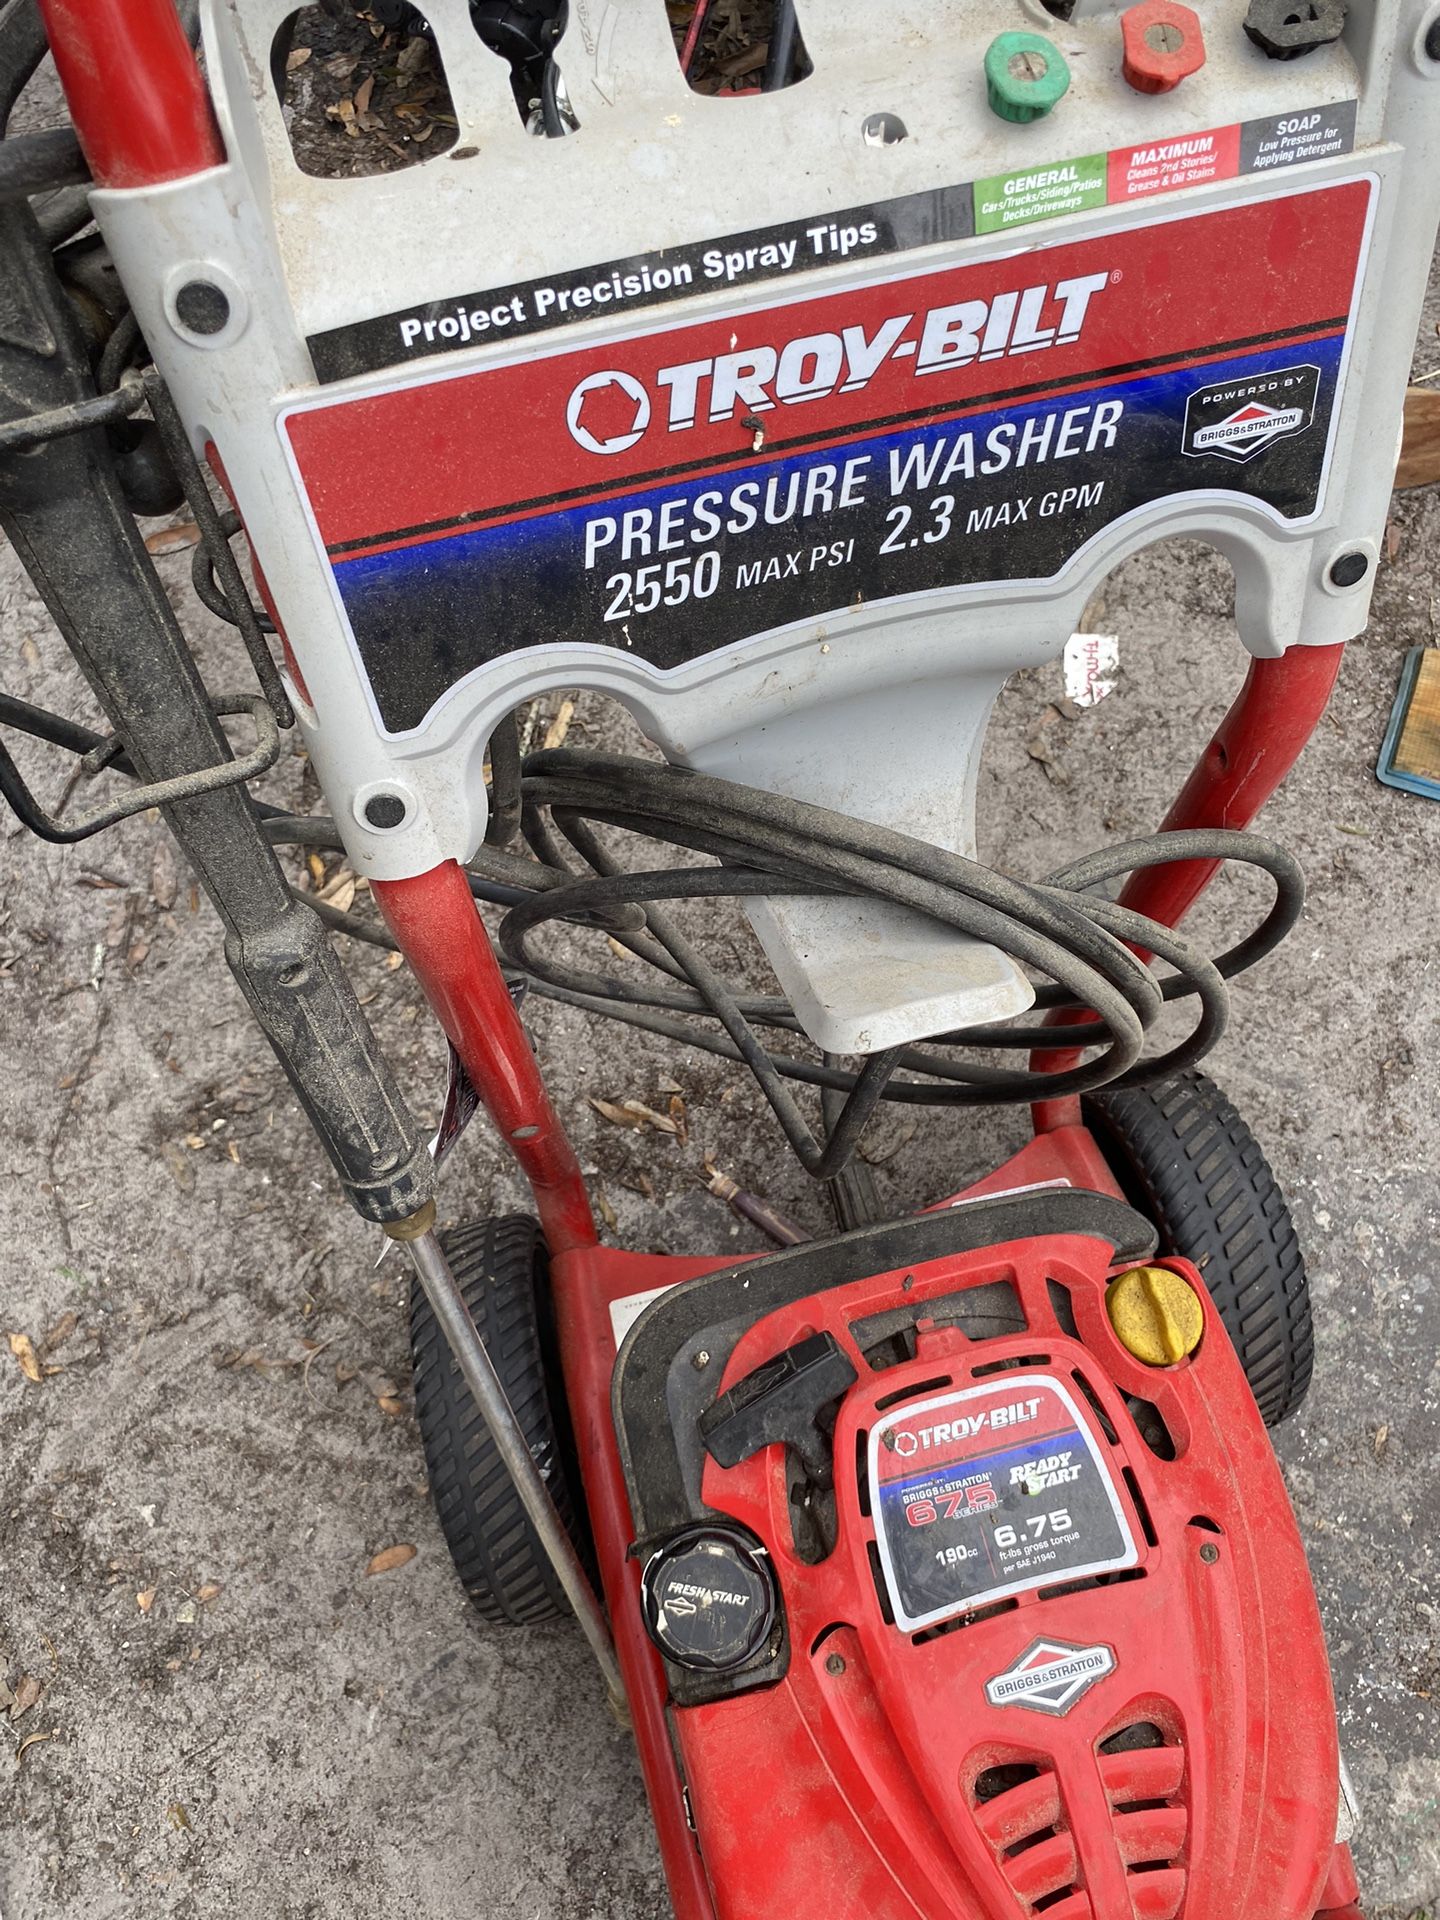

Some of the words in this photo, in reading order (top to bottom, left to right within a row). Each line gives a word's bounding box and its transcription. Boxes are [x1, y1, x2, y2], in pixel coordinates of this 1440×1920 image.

[1276, 114, 1321, 135] SOAP
[1131, 136, 1214, 167] MAXIMUM
[1253, 150, 1294, 167] Applying
[1296, 138, 1342, 158] Detergent
[1258, 141, 1279, 153] Low
[1280, 132, 1322, 148] Pressure
[1323, 128, 1338, 139] for
[1003, 166, 1078, 195] GENERAL
[1127, 165, 1158, 181] Cleans
[1159, 161, 1179, 174] 2nd
[1180, 152, 1217, 170] Stories/
[1127, 179, 1160, 194] Grease
[1161, 175, 1169, 186] &
[1171, 171, 1185, 184] Oil
[1186, 167, 1216, 181] Stains
[981, 177, 1103, 214] Cars/Trucks/Siding/Patios
[1002, 195, 1083, 223] Decks/Driveways
[400, 296, 526, 347] Project
[534, 262, 693, 317] Precision
[702, 239, 797, 281] Spray
[806, 222, 878, 255] Tips
[657, 271, 1109, 432] TROY-BILT
[1202, 381, 1279, 405] POWERED
[1284, 376, 1304, 387] BY
[584, 455, 871, 570] PRESSURE
[889, 400, 1124, 497] WASHER
[604, 551, 721, 622] 2550
[736, 551, 801, 589] MAX
[809, 538, 855, 571] PSI
[878, 494, 955, 555] 2.3
[966, 497, 1033, 535] MAX
[1039, 481, 1105, 517] GPM
[918, 1398, 1041, 1449] TROY-BILT
[1010, 1451, 1072, 1485] READY
[1027, 1464, 1082, 1494] START
[906, 1481, 997, 1527] 675
[994, 1508, 1073, 1548] 6.75
[936, 1544, 978, 1566] 190cc
[999, 1548, 1022, 1561] ft-lbs
[1024, 1540, 1049, 1556] gross
[1050, 1531, 1080, 1546] torque
[1003, 1564, 1015, 1575] per
[1016, 1559, 1031, 1569] SAE
[668, 1581, 706, 1598] FRESH
[712, 1590, 750, 1606] START
